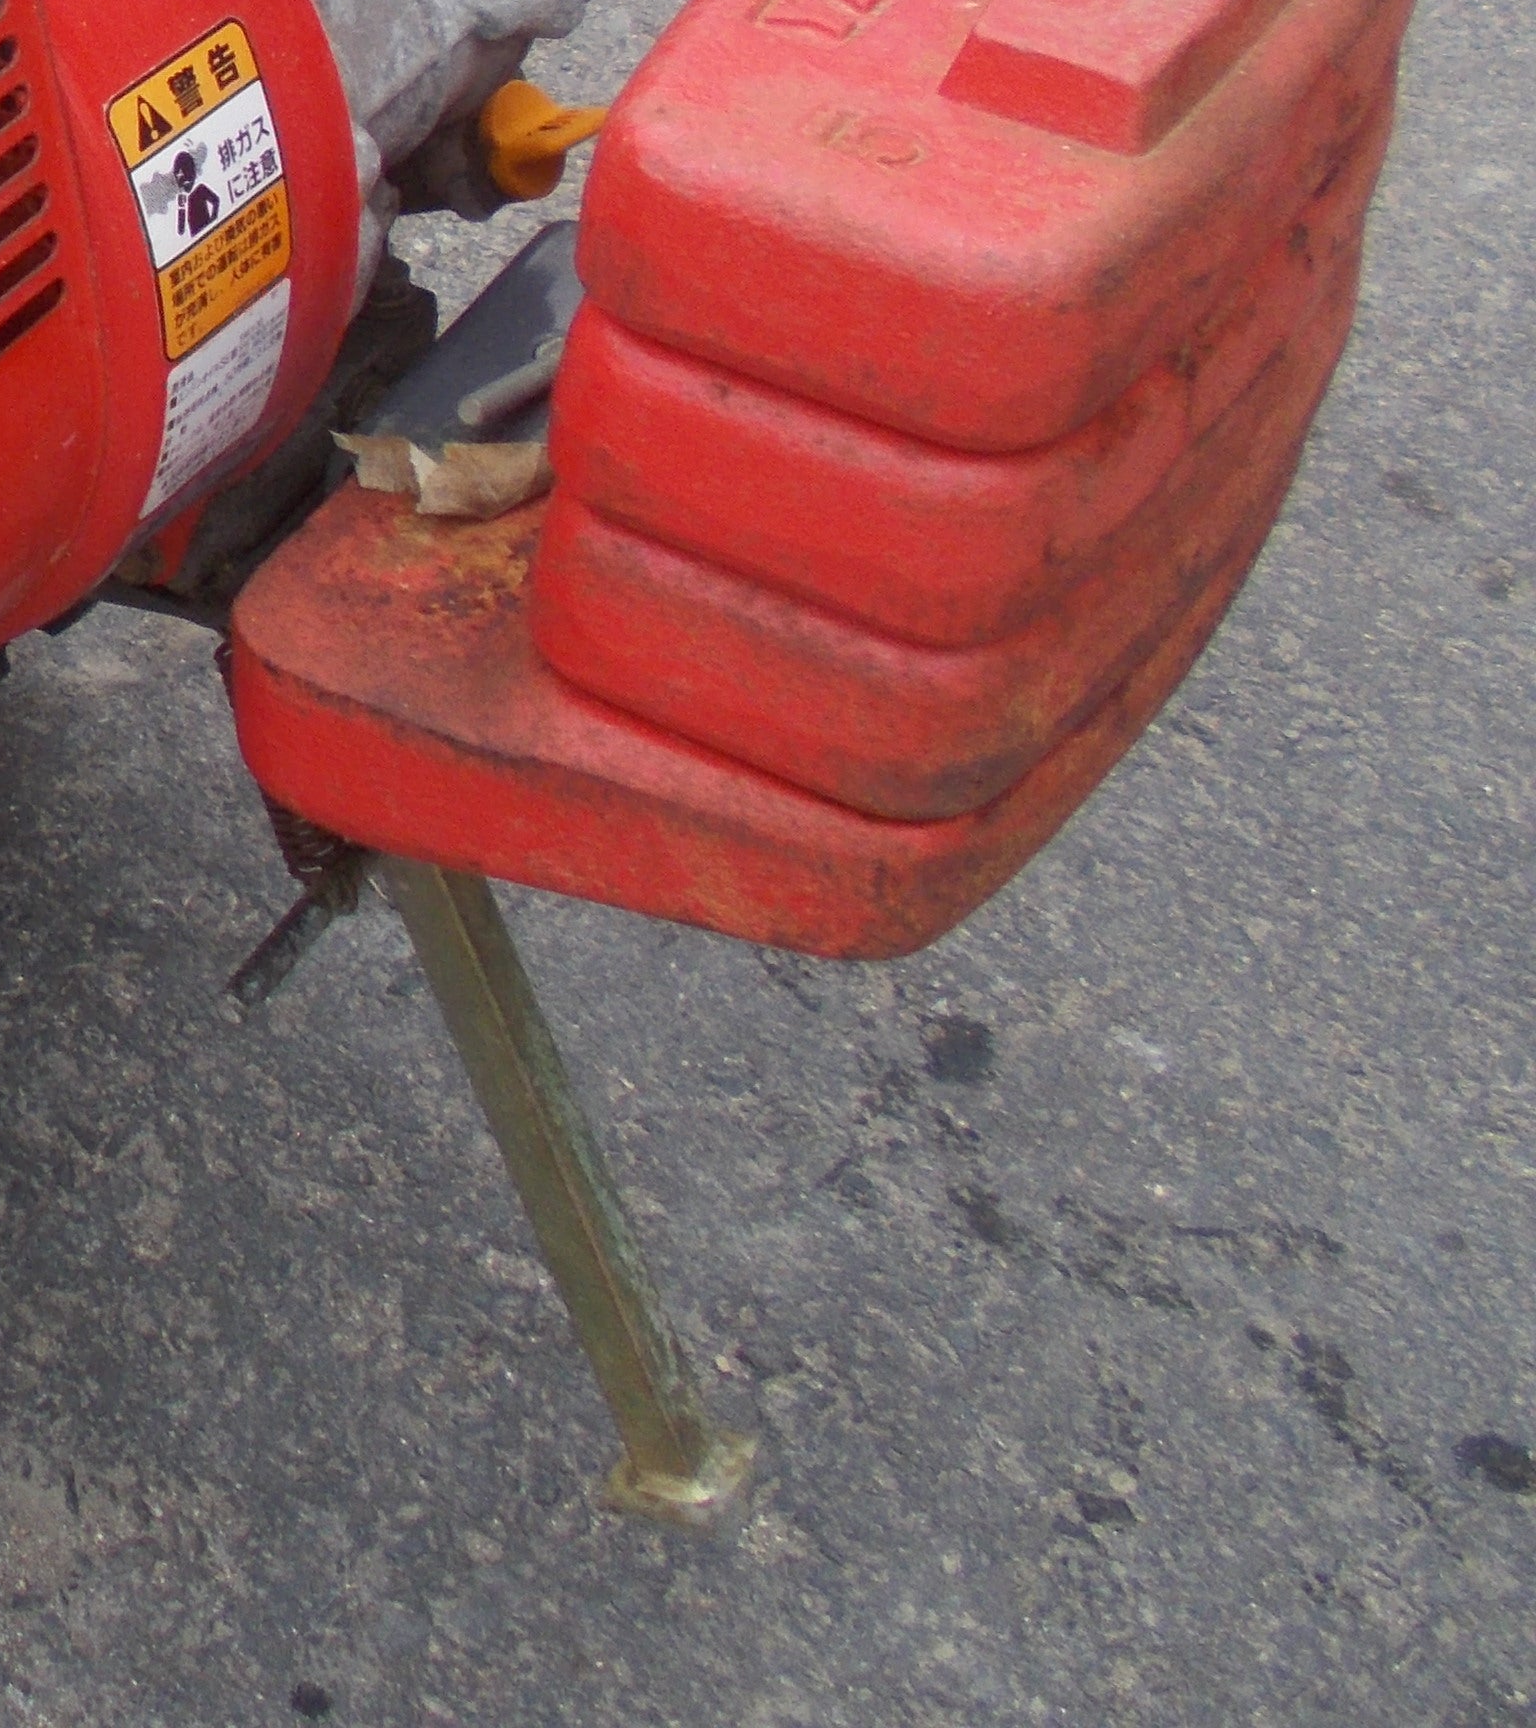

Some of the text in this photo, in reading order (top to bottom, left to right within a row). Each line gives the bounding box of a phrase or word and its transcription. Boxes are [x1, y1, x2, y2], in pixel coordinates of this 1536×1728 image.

[167, 43, 240, 118] 警告
[217, 115, 270, 171] 排ガス
[228, 148, 280, 204] に注意
